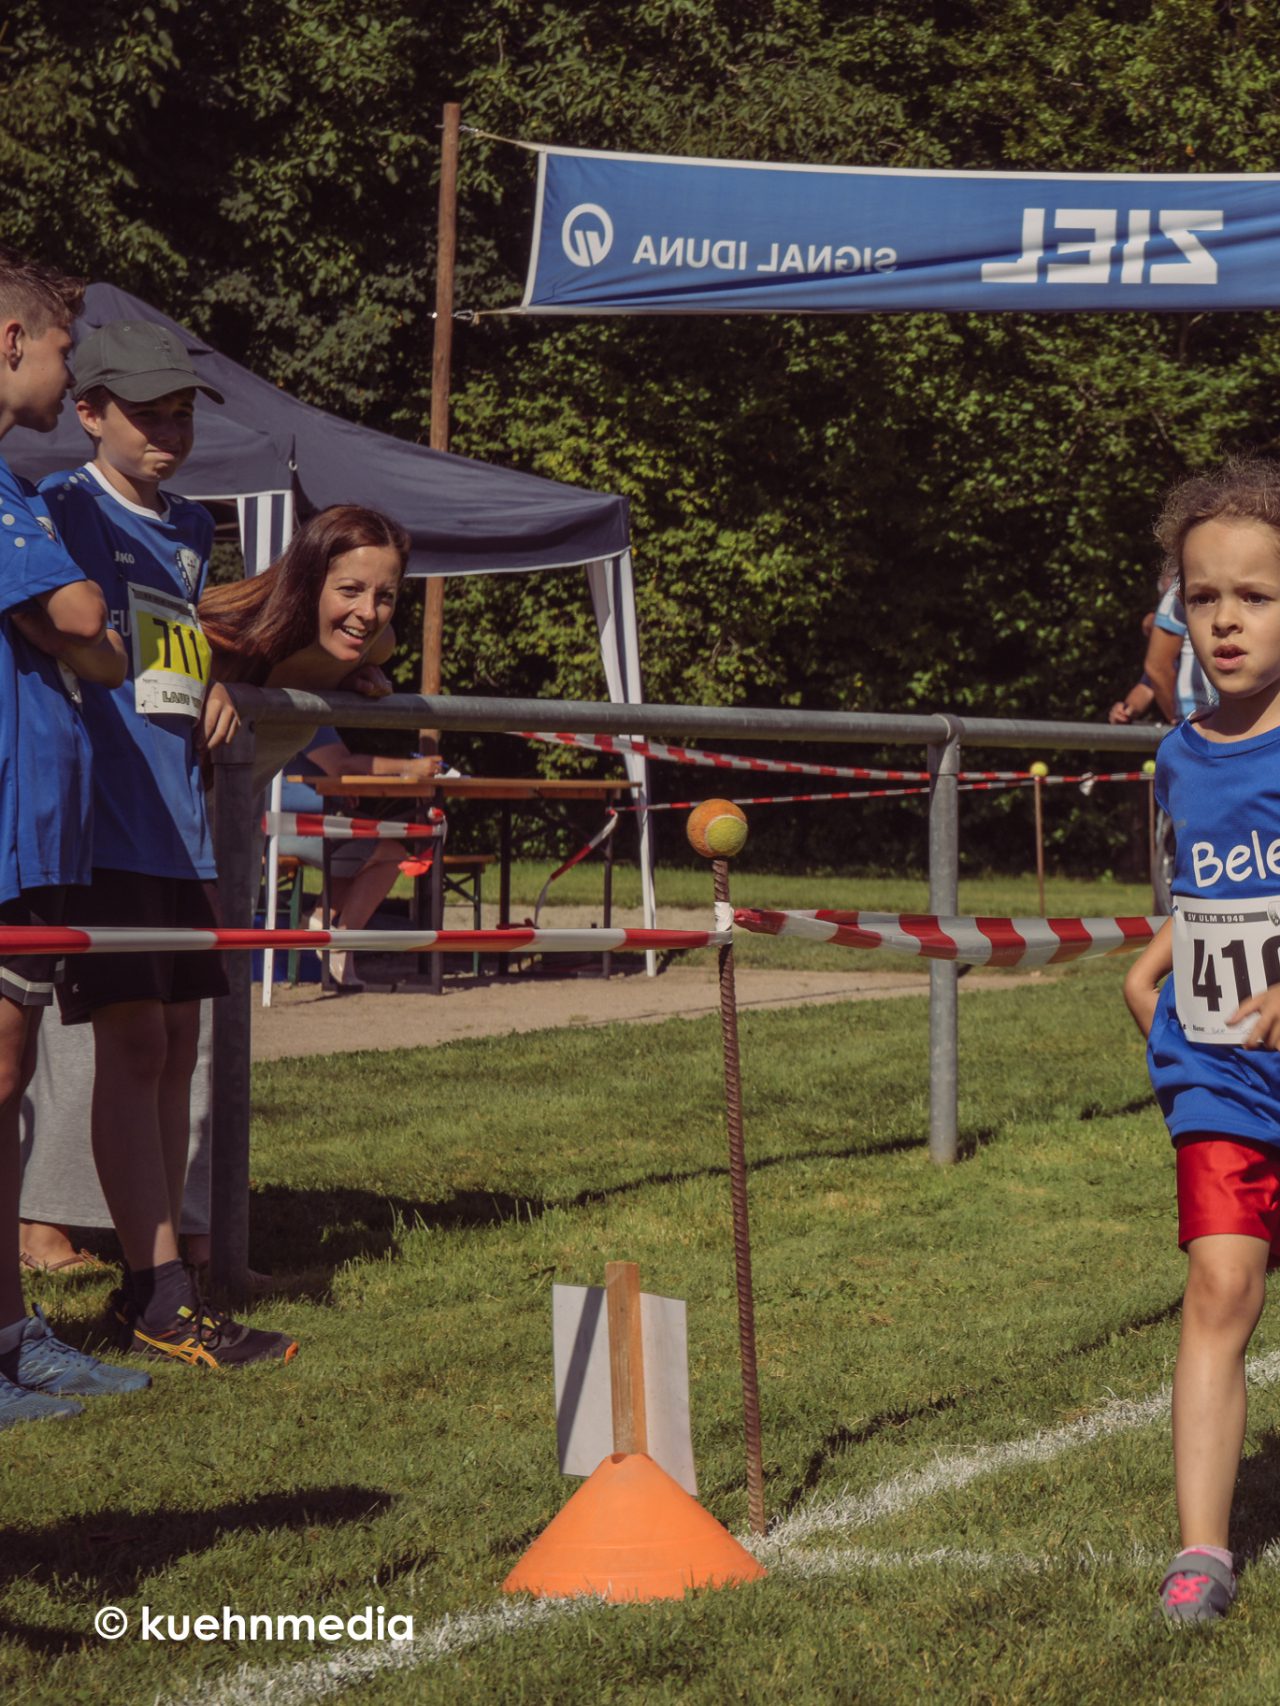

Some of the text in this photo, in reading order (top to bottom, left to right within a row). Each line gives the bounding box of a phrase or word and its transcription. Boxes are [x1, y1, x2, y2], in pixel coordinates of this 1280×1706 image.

[153, 617, 203, 681] 711
[1187, 913, 1196, 921] SV
[1199, 914, 1218, 922] ULM
